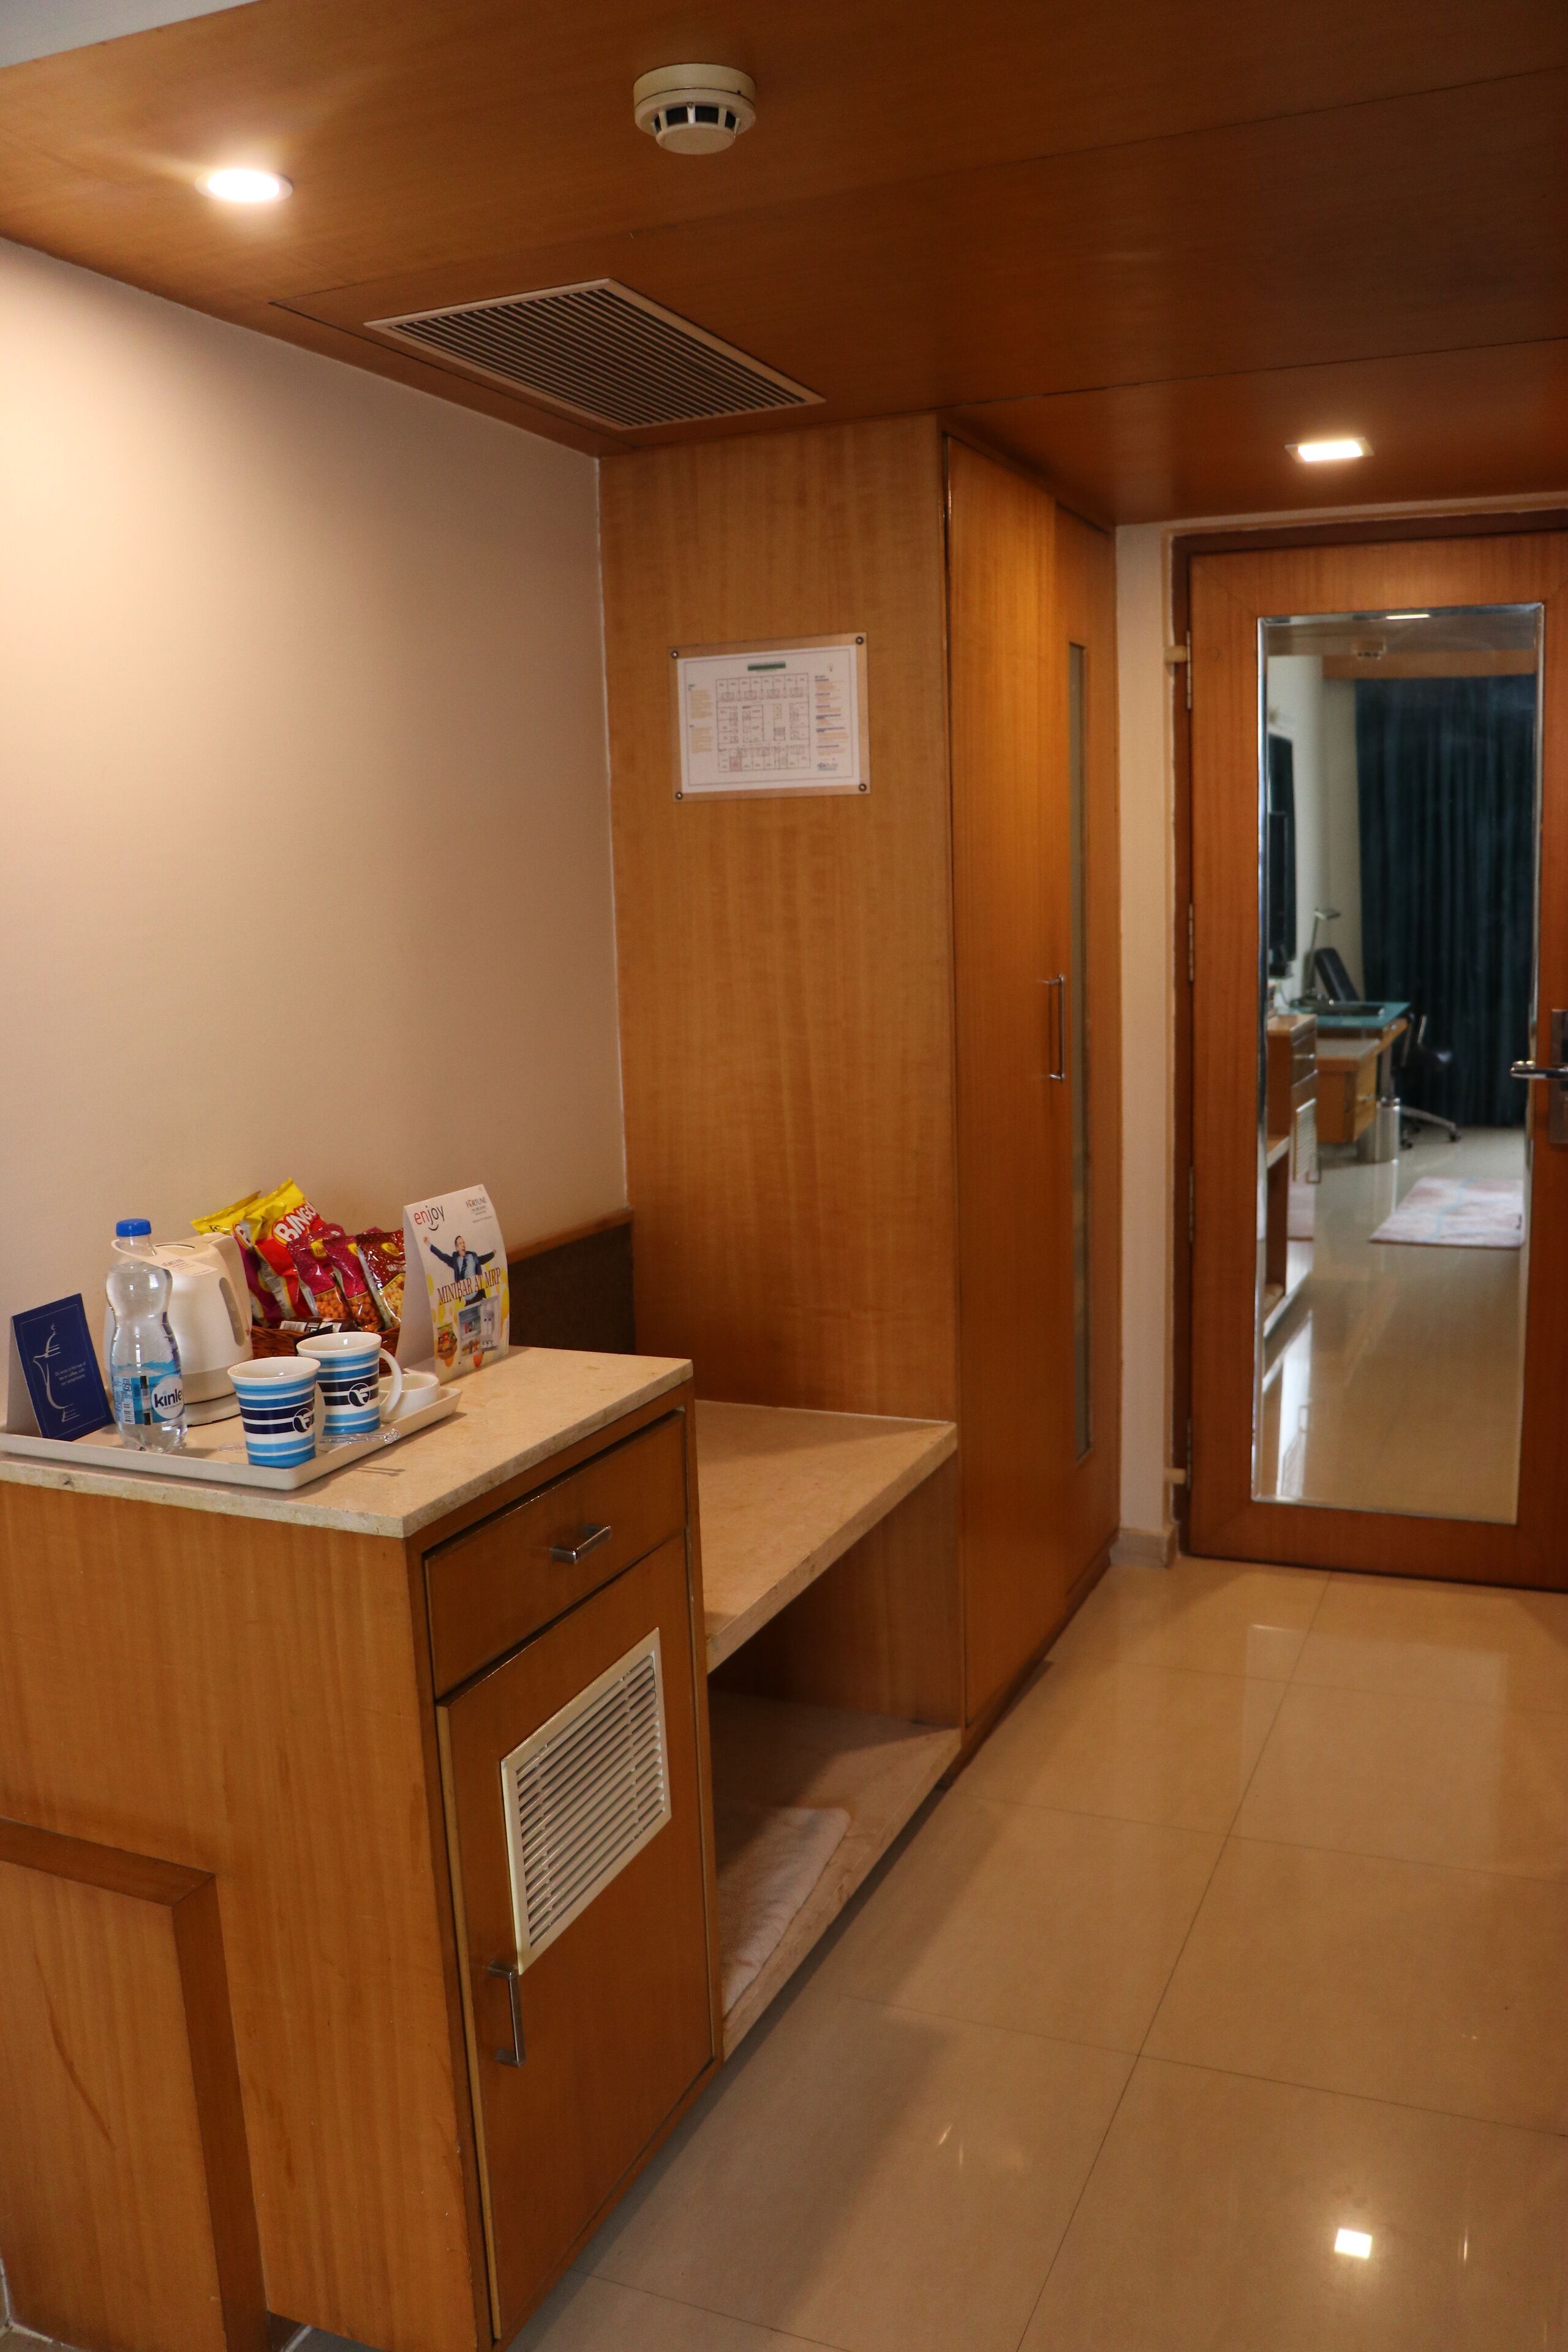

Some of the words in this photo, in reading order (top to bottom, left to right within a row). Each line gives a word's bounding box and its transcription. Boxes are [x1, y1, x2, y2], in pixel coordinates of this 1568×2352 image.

[414, 1205, 445, 1225] enjoy
[437, 1278, 473, 1305] MINIBAR
[475, 1273, 483, 1292] AT
[484, 1267, 501, 1288] MRP
[154, 1389, 184, 1408] kinle
